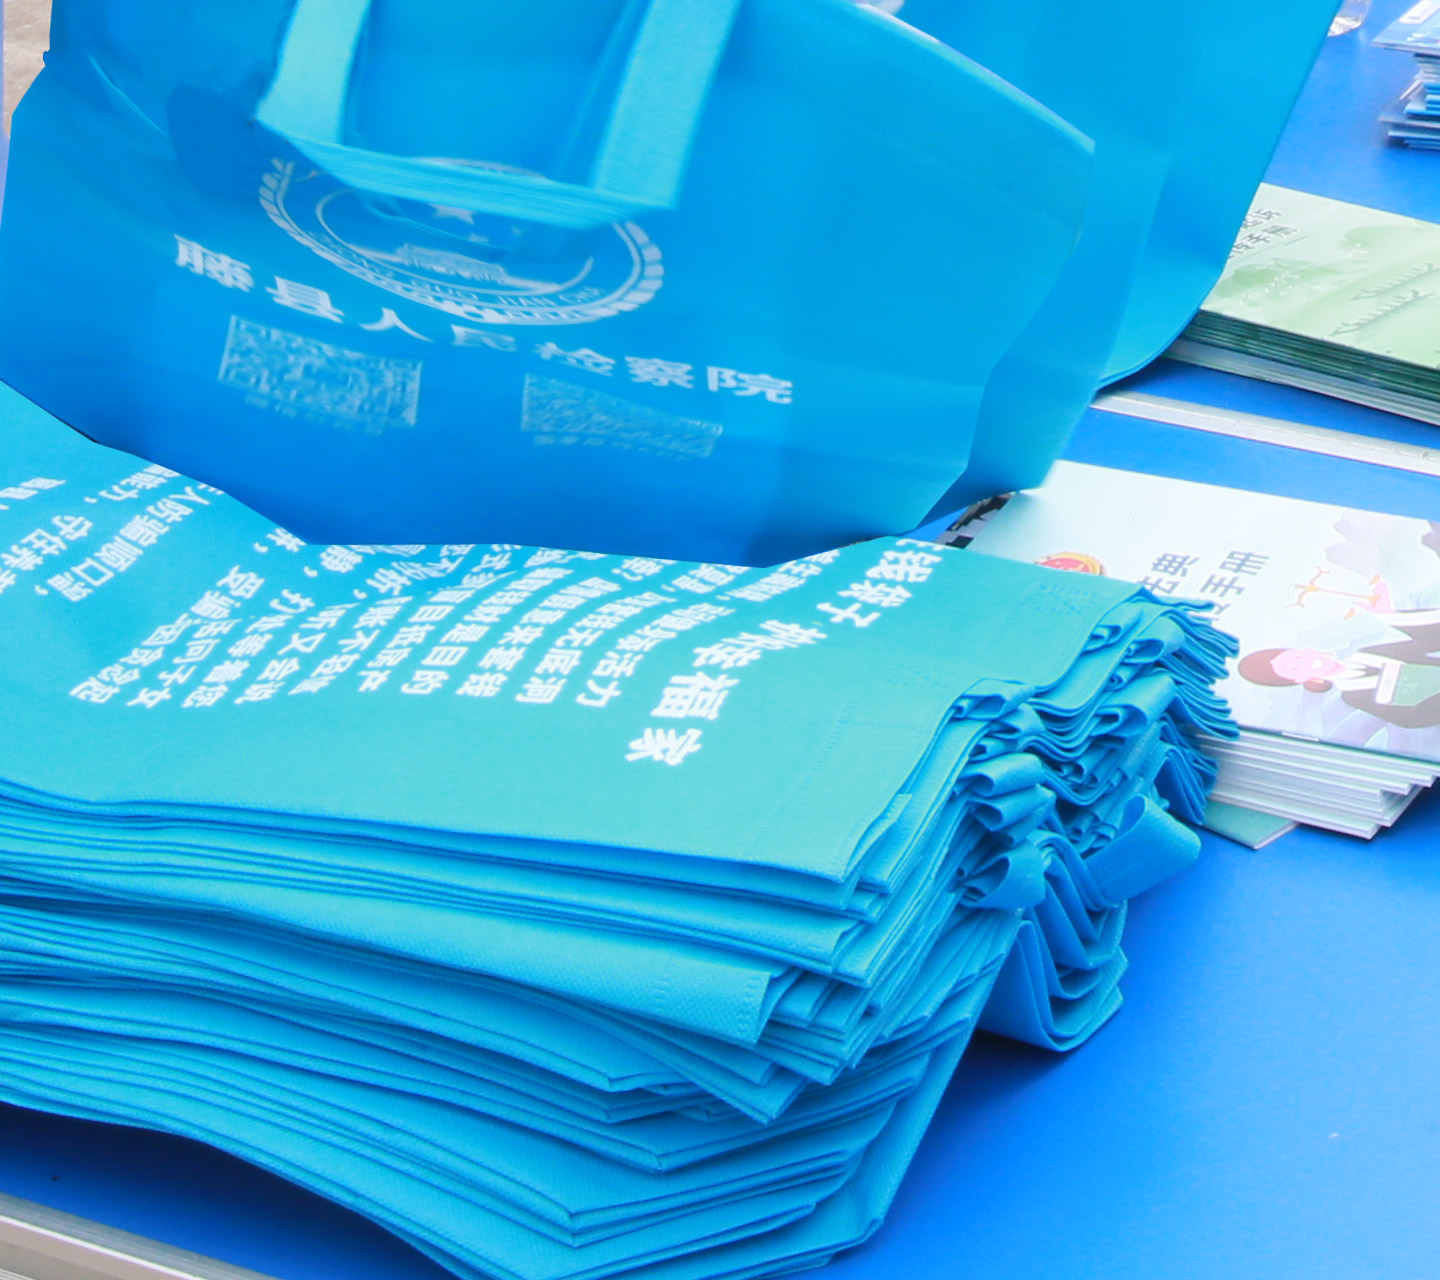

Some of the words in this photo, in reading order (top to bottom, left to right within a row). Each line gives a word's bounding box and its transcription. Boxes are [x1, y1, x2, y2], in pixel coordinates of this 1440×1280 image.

[174, 234, 793, 405] 藤县人民检察院
